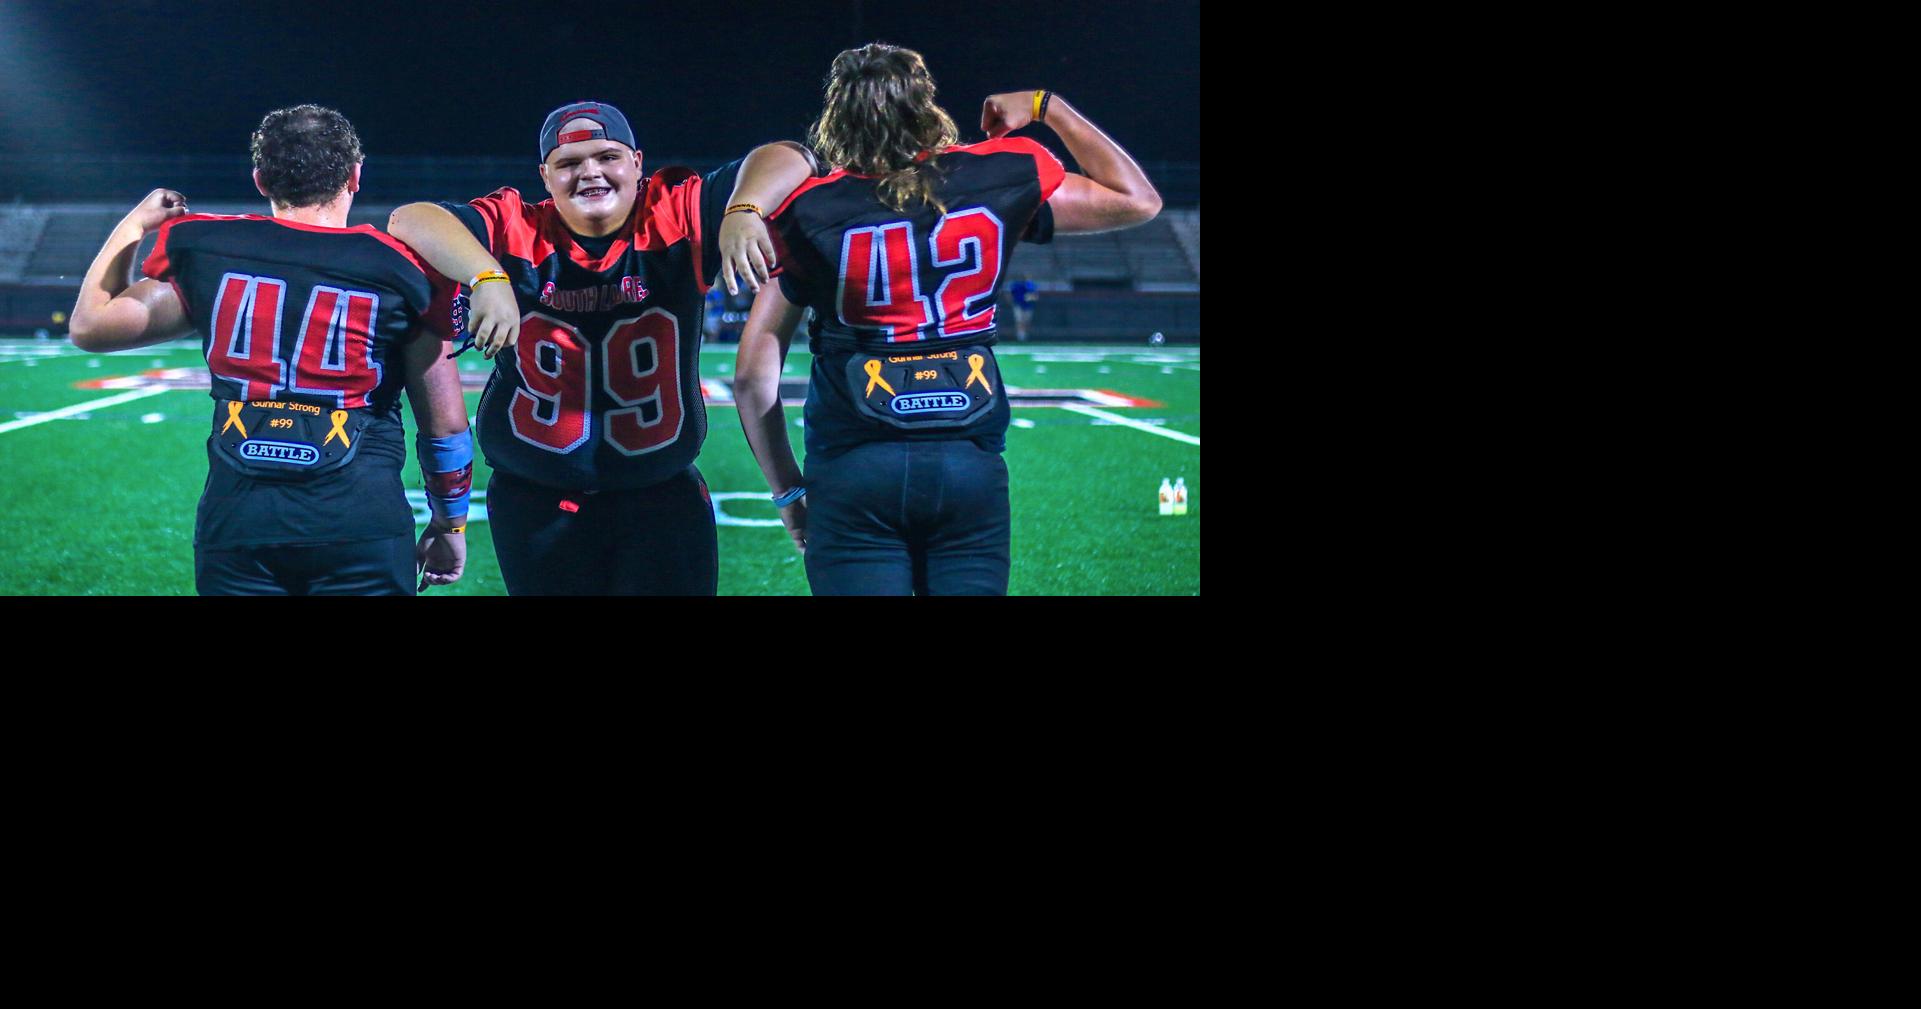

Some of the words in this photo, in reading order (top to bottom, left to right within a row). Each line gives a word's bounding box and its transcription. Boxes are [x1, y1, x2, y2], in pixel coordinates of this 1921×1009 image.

[836, 206, 1003, 343] 42
[540, 281, 598, 312] SOUTH
[206, 272, 383, 409] 44
[508, 306, 685, 456] 99
[914, 370, 937, 380] #99
[288, 401, 321, 416] Strong
[899, 396, 963, 410] BATTLE
[270, 418, 293, 429] #99
[246, 444, 312, 460] BATTLE
